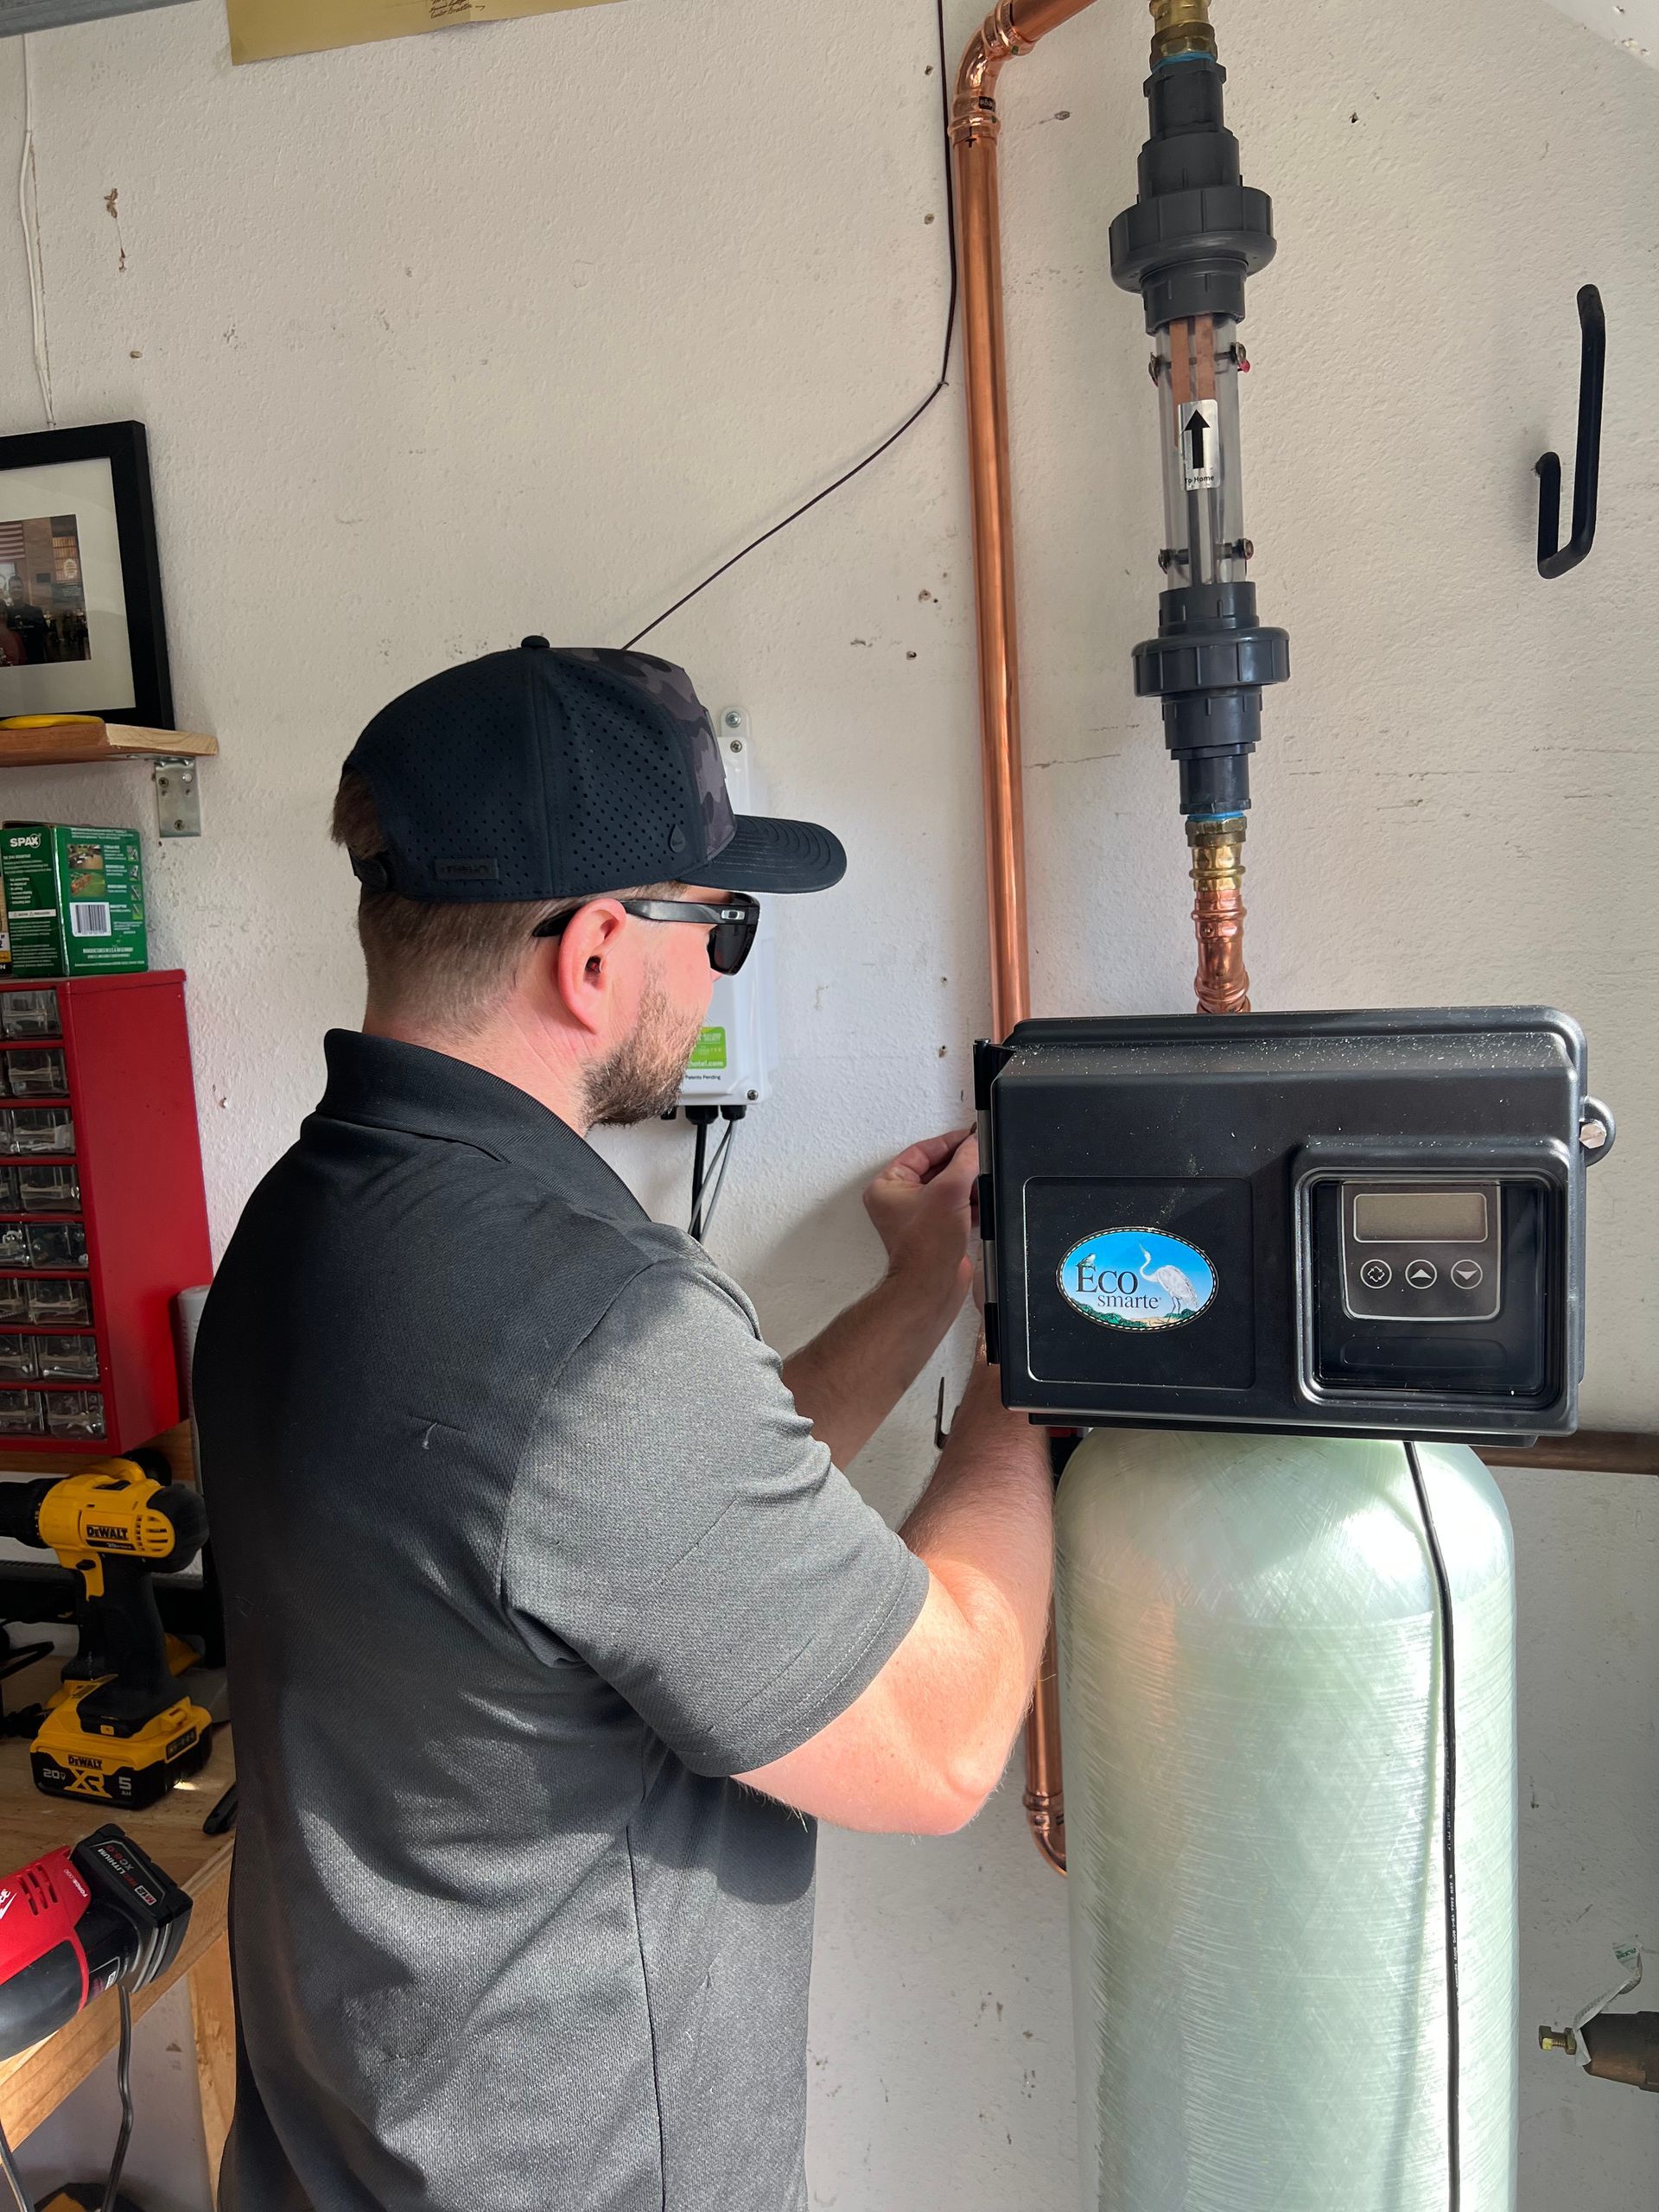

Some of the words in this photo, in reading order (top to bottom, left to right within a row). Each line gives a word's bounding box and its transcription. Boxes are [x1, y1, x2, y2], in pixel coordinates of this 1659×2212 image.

[1193, 475, 1215, 484] Home
[10, 833, 41, 849] SPAX
[118, 1776, 132, 1790] 5
